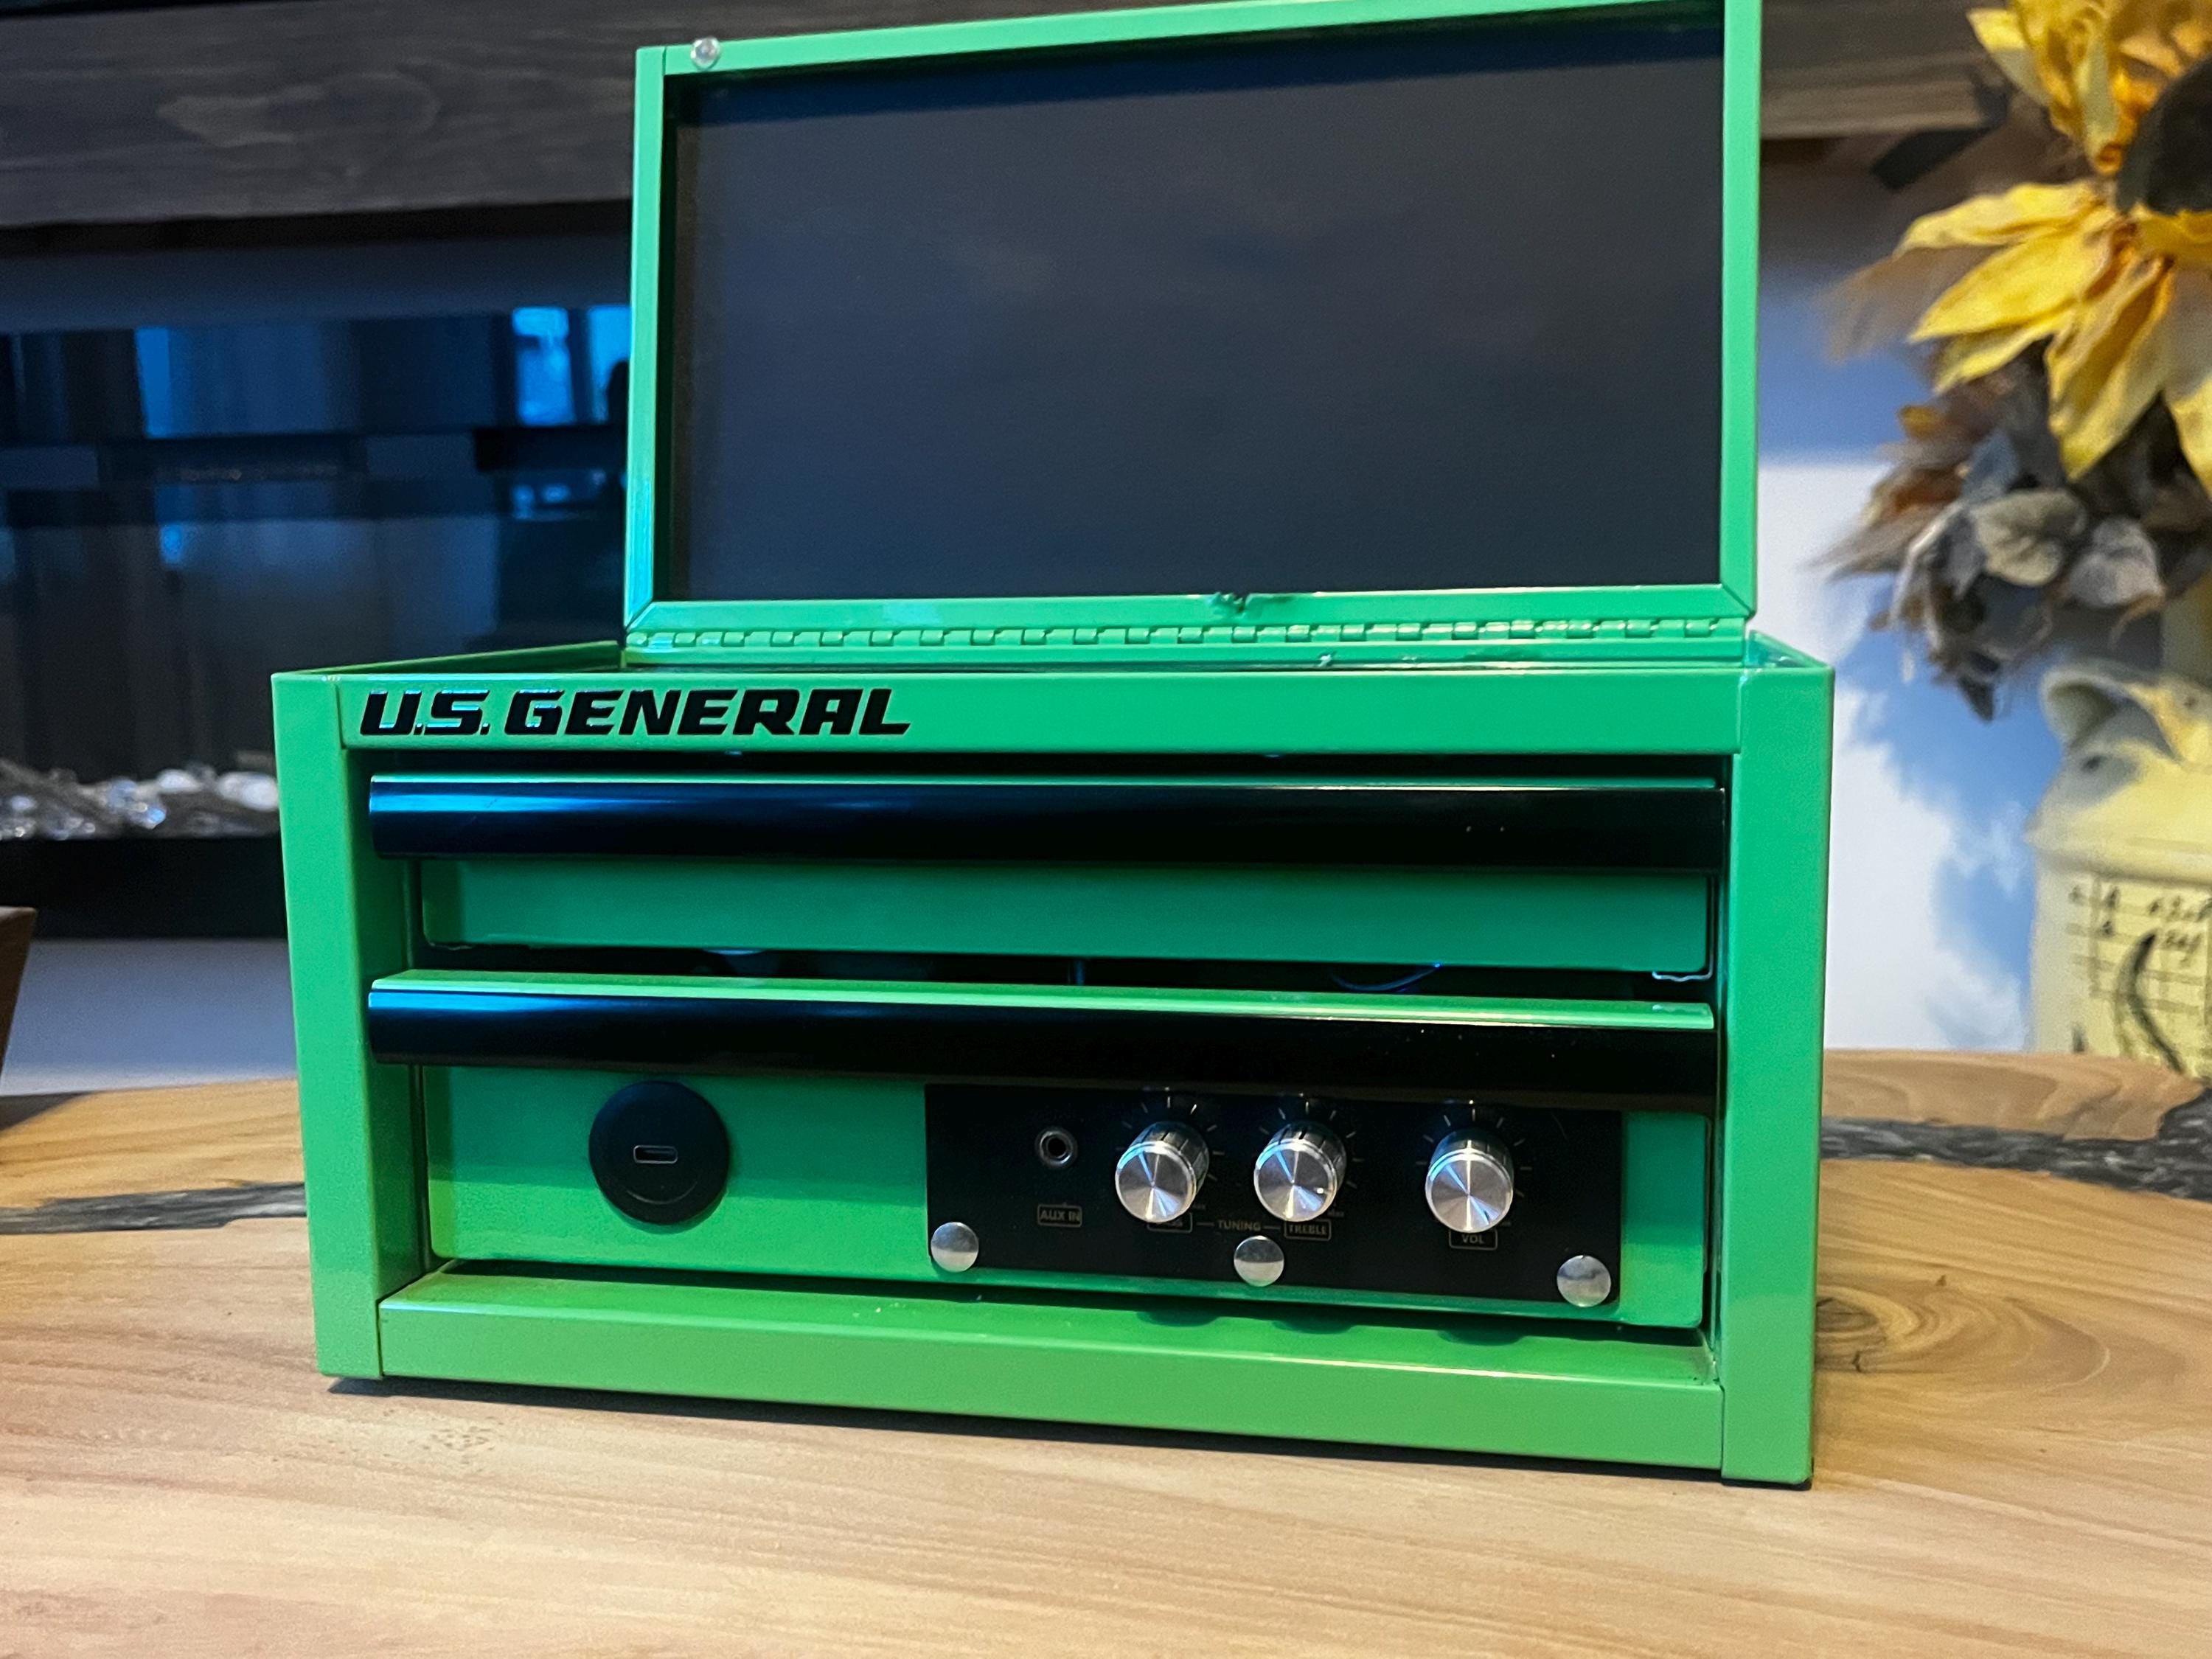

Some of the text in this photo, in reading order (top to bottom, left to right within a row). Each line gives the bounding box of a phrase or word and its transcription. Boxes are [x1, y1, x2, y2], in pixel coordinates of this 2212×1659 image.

[359, 688, 911, 736] U.S. GENERAL
[1040, 1208, 1080, 1222] AUX IN
[1217, 1219, 1262, 1232] TUNING
[1289, 1224, 1327, 1236] TREBLE
[1461, 1233, 1486, 1245] VOL
